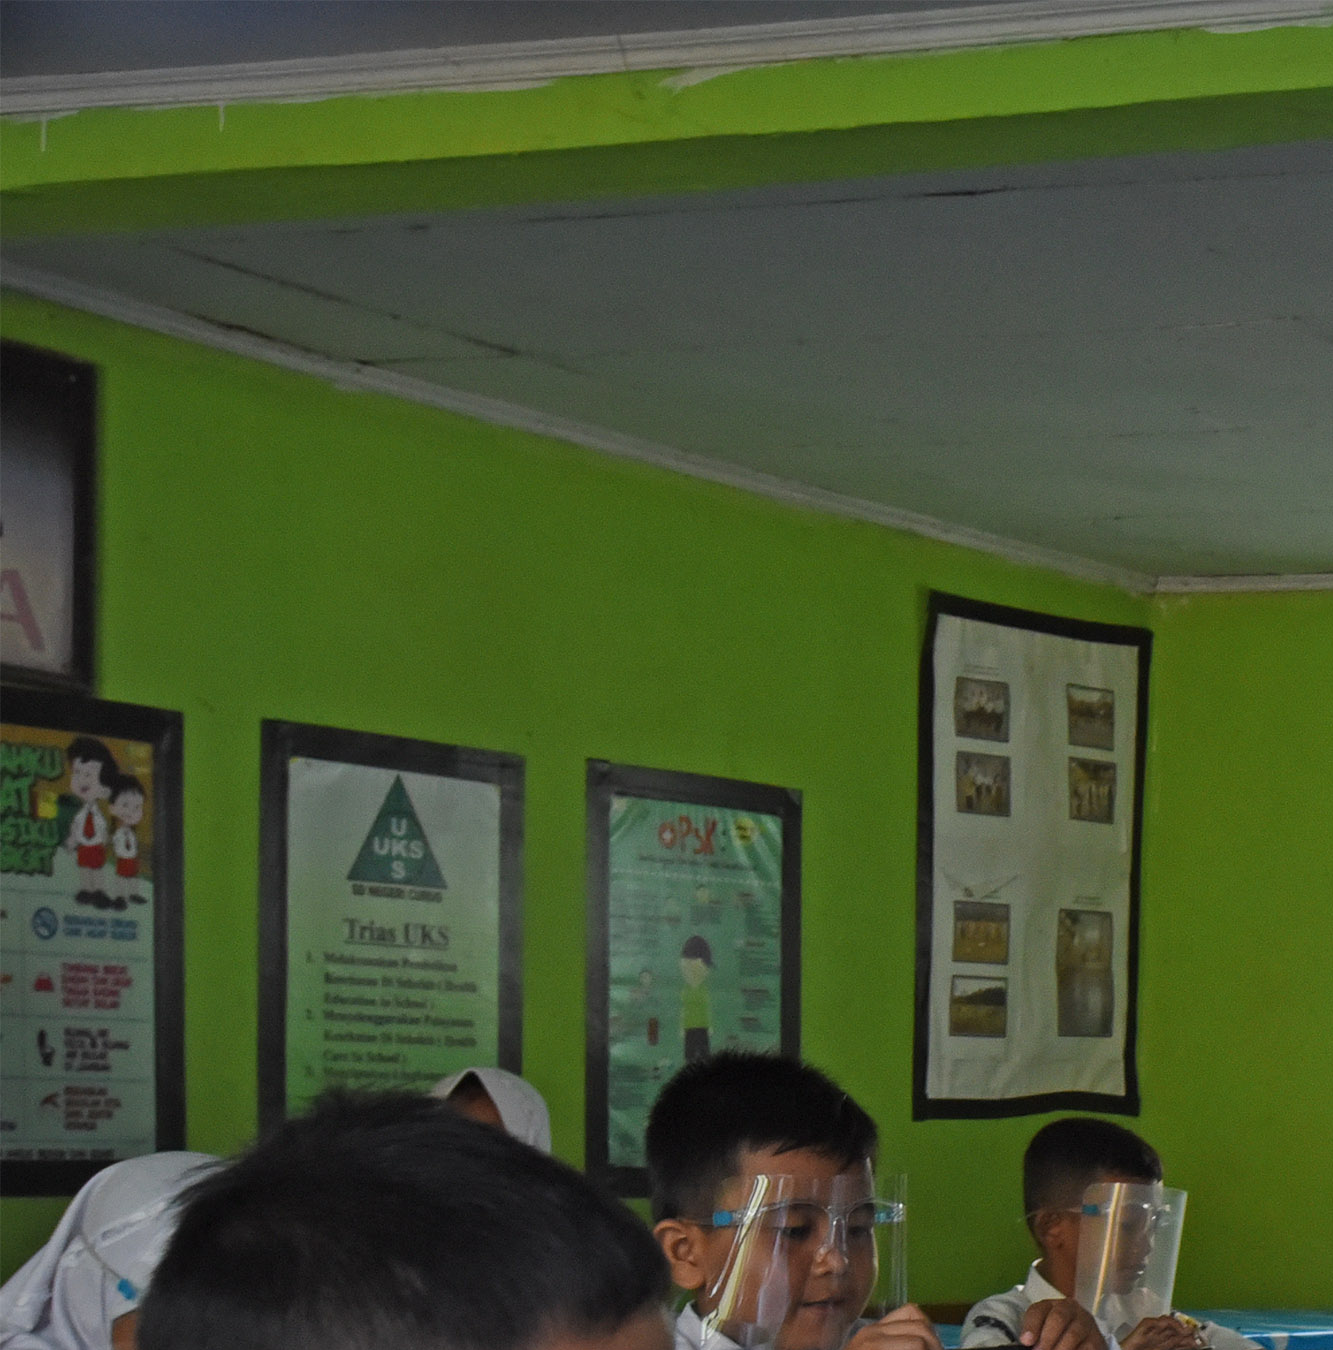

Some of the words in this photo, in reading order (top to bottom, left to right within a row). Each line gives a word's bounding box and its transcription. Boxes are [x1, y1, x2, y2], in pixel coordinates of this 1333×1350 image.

[372, 835, 425, 860] UKS
[342, 917, 396, 944] Trias
[403, 921, 451, 946] UKS
